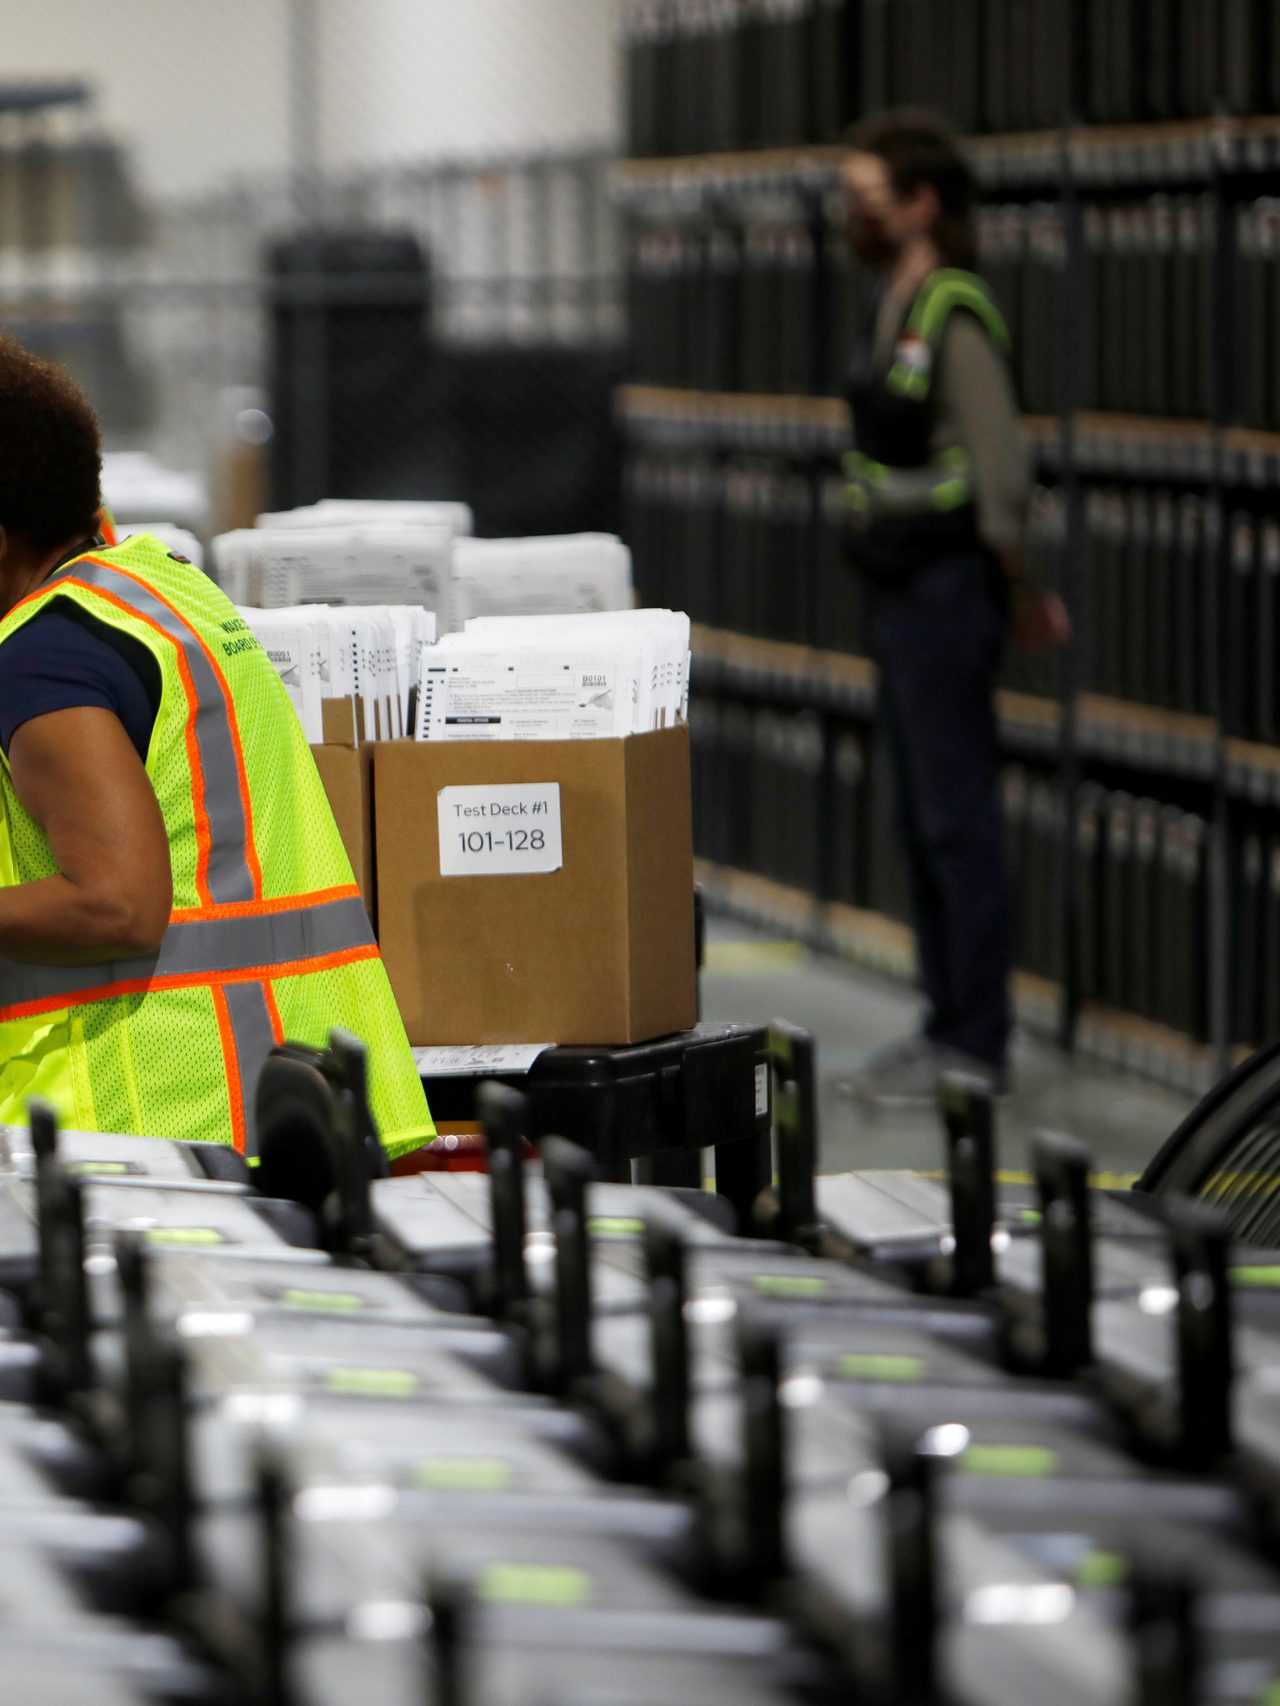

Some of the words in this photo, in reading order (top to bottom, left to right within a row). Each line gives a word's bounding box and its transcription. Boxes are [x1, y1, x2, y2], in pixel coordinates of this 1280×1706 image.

[222, 637, 252, 656] BOARD
[453, 804, 486, 817] Test
[490, 802, 529, 816] Deck
[532, 801, 548, 814] #1
[458, 829, 545, 853] 101-128
